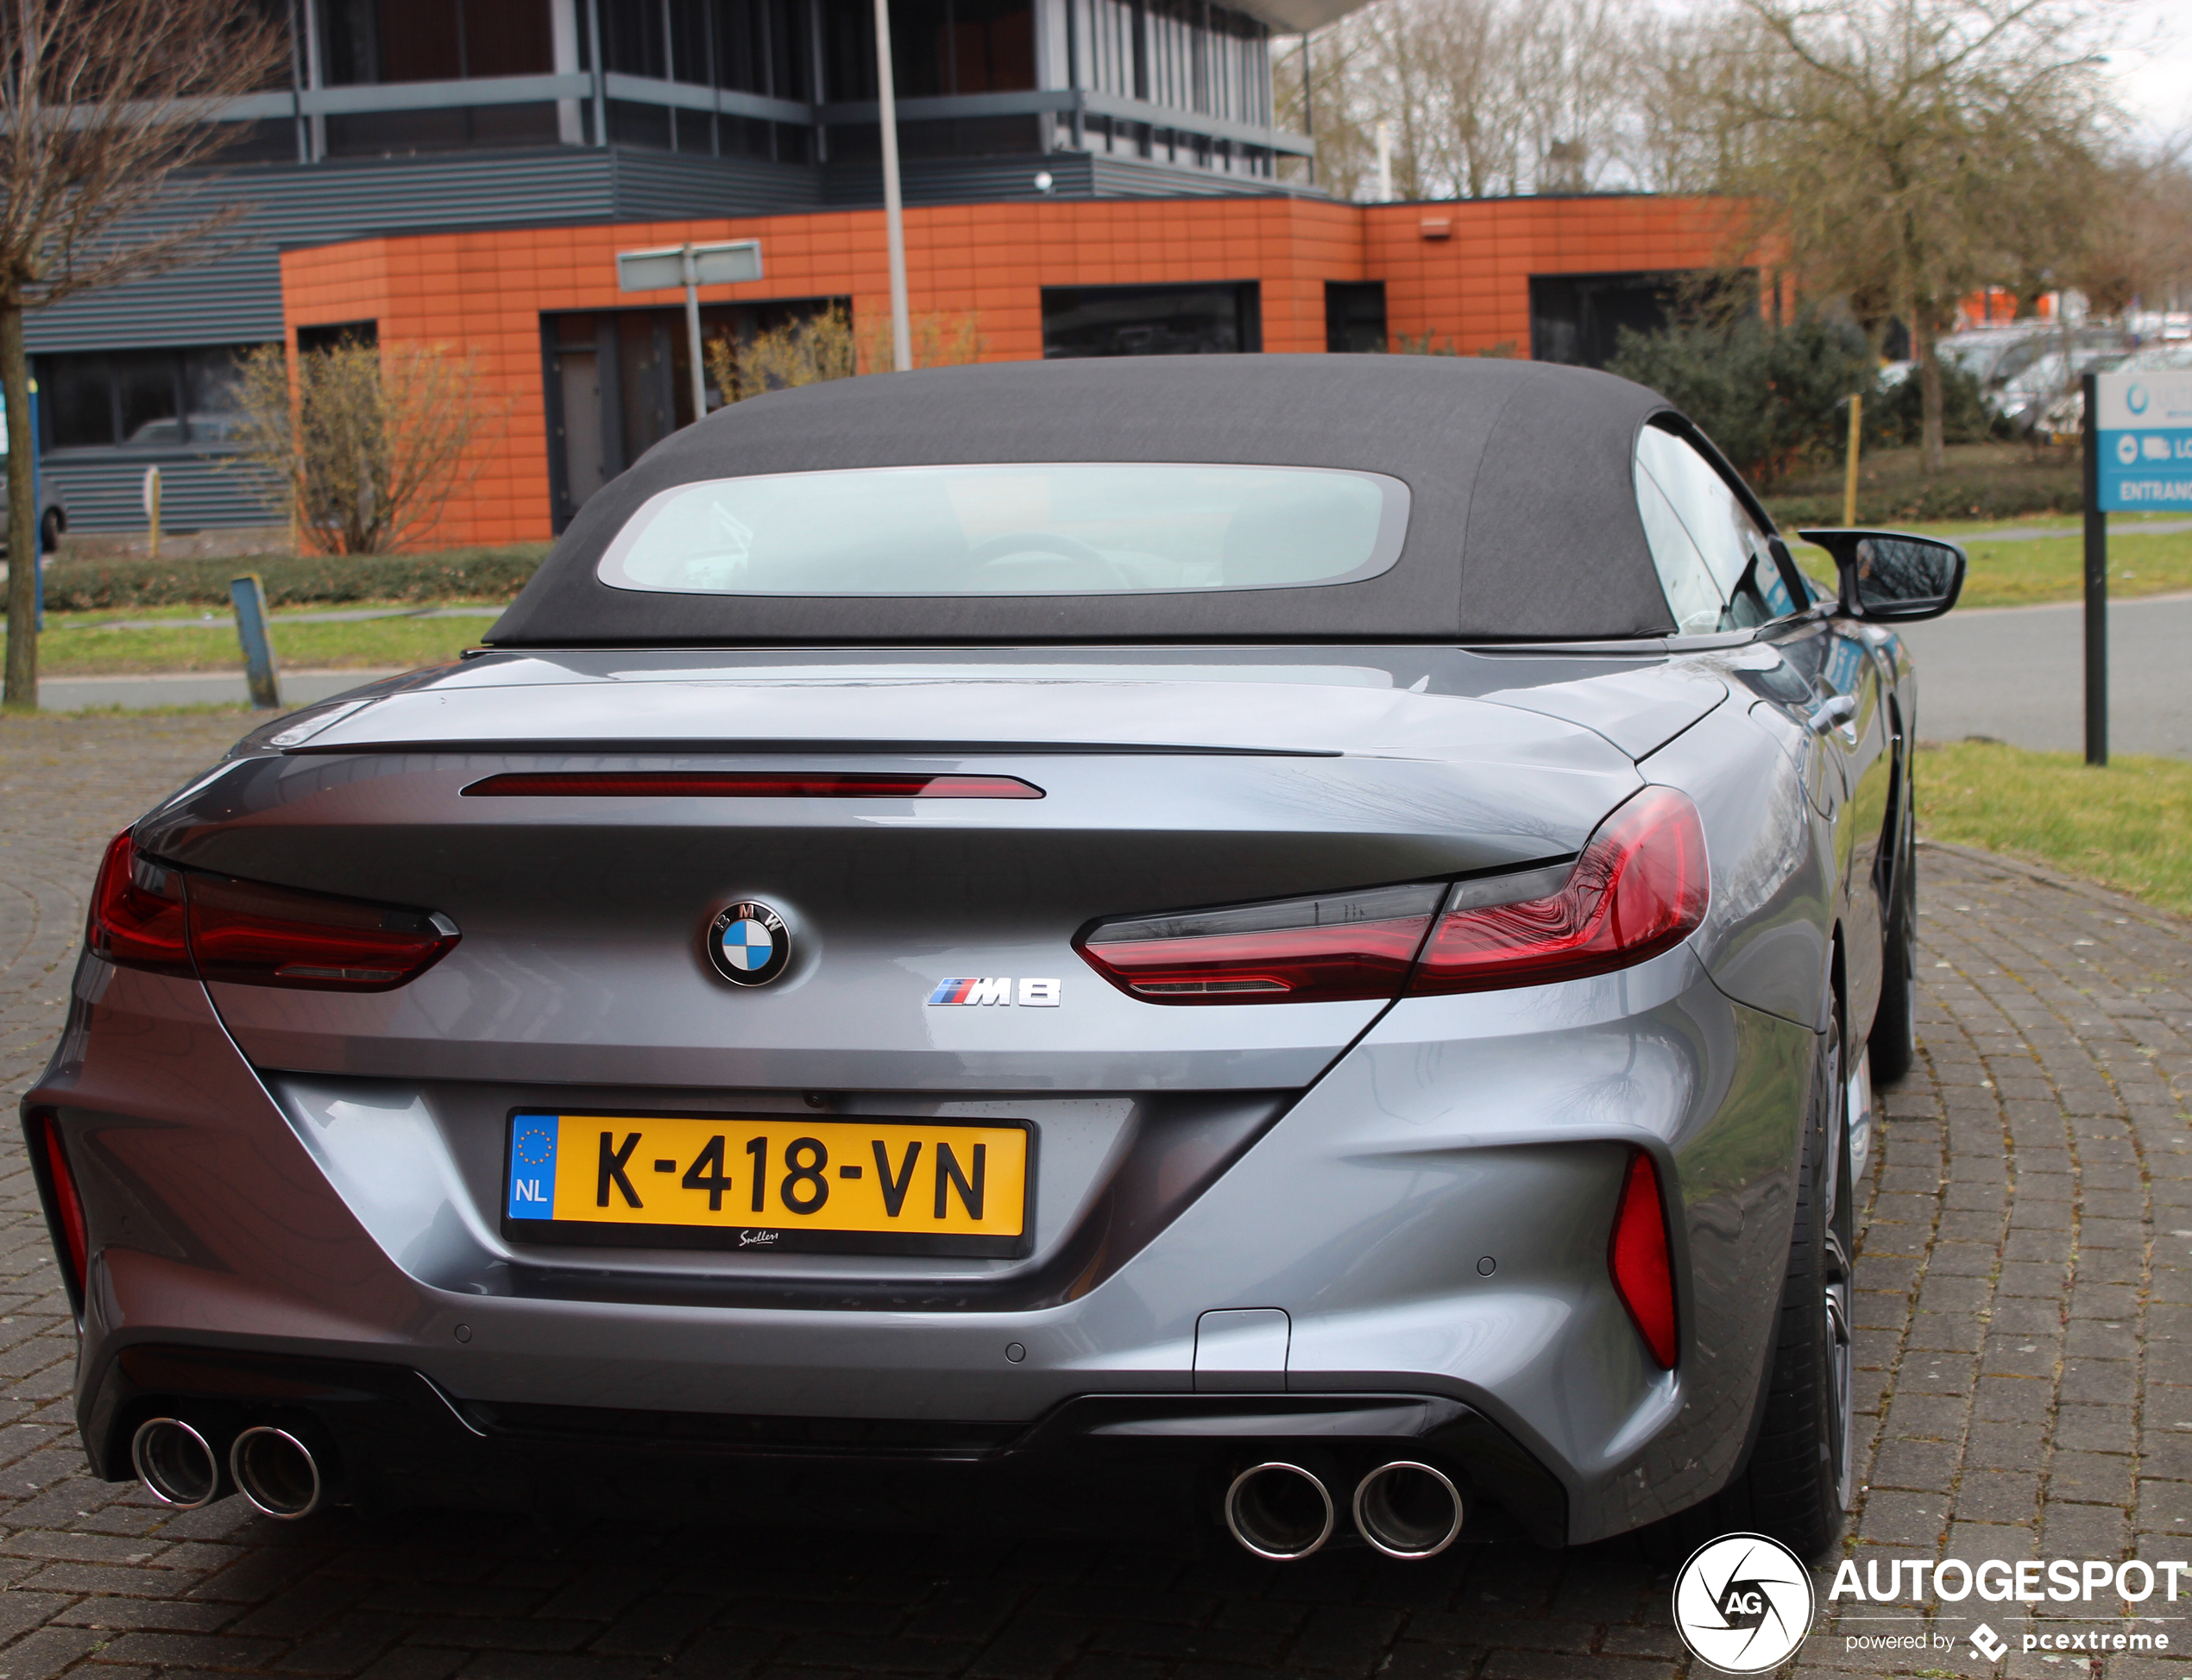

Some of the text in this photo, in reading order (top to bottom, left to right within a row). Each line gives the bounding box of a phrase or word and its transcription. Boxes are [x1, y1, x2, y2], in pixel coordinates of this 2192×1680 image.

[715, 904, 782, 932] BMW
[597, 1132, 986, 1219] K-418-VN
[516, 1179, 547, 1202] NL
[739, 1230, 778, 1247] Snellers
